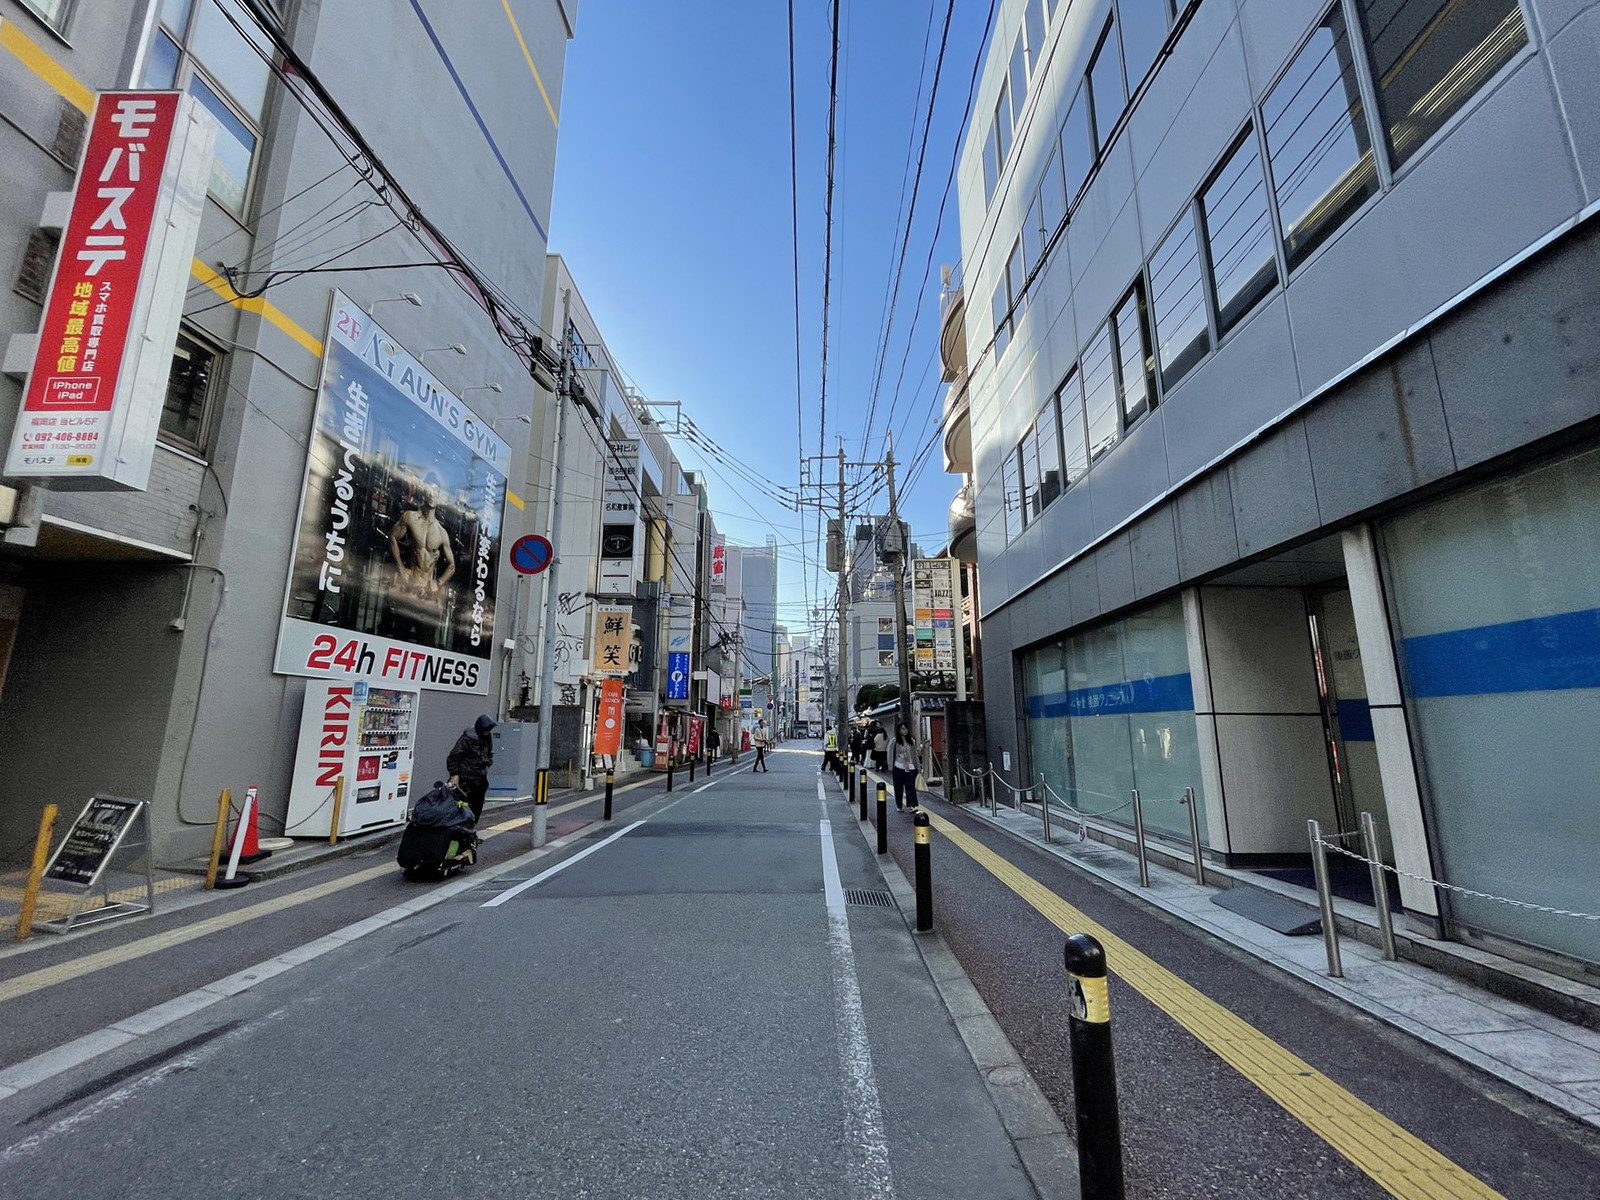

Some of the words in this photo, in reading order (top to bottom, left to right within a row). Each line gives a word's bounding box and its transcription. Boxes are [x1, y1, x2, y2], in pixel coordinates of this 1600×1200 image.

[77, 100, 157, 276] モバステ
[57, 282, 93, 373] 地域最高値
[81, 282, 112, 372] スマホ買取専門店
[336, 309, 362, 342] 2F
[53, 381, 93, 390] iPhone
[57, 391, 83, 400] iPad
[400, 366, 460, 429] AUN'S
[463, 419, 497, 462] GYM
[318, 380, 369, 593] 生きてるうちに
[470, 473, 497, 647] 生まれ変わるなら
[713, 545, 725, 575] 麻雀
[306, 634, 376, 675] 24h
[381, 647, 480, 688] FITNESS
[603, 616, 624, 666] 鮮笑
[315, 686, 353, 787] KIRIN
